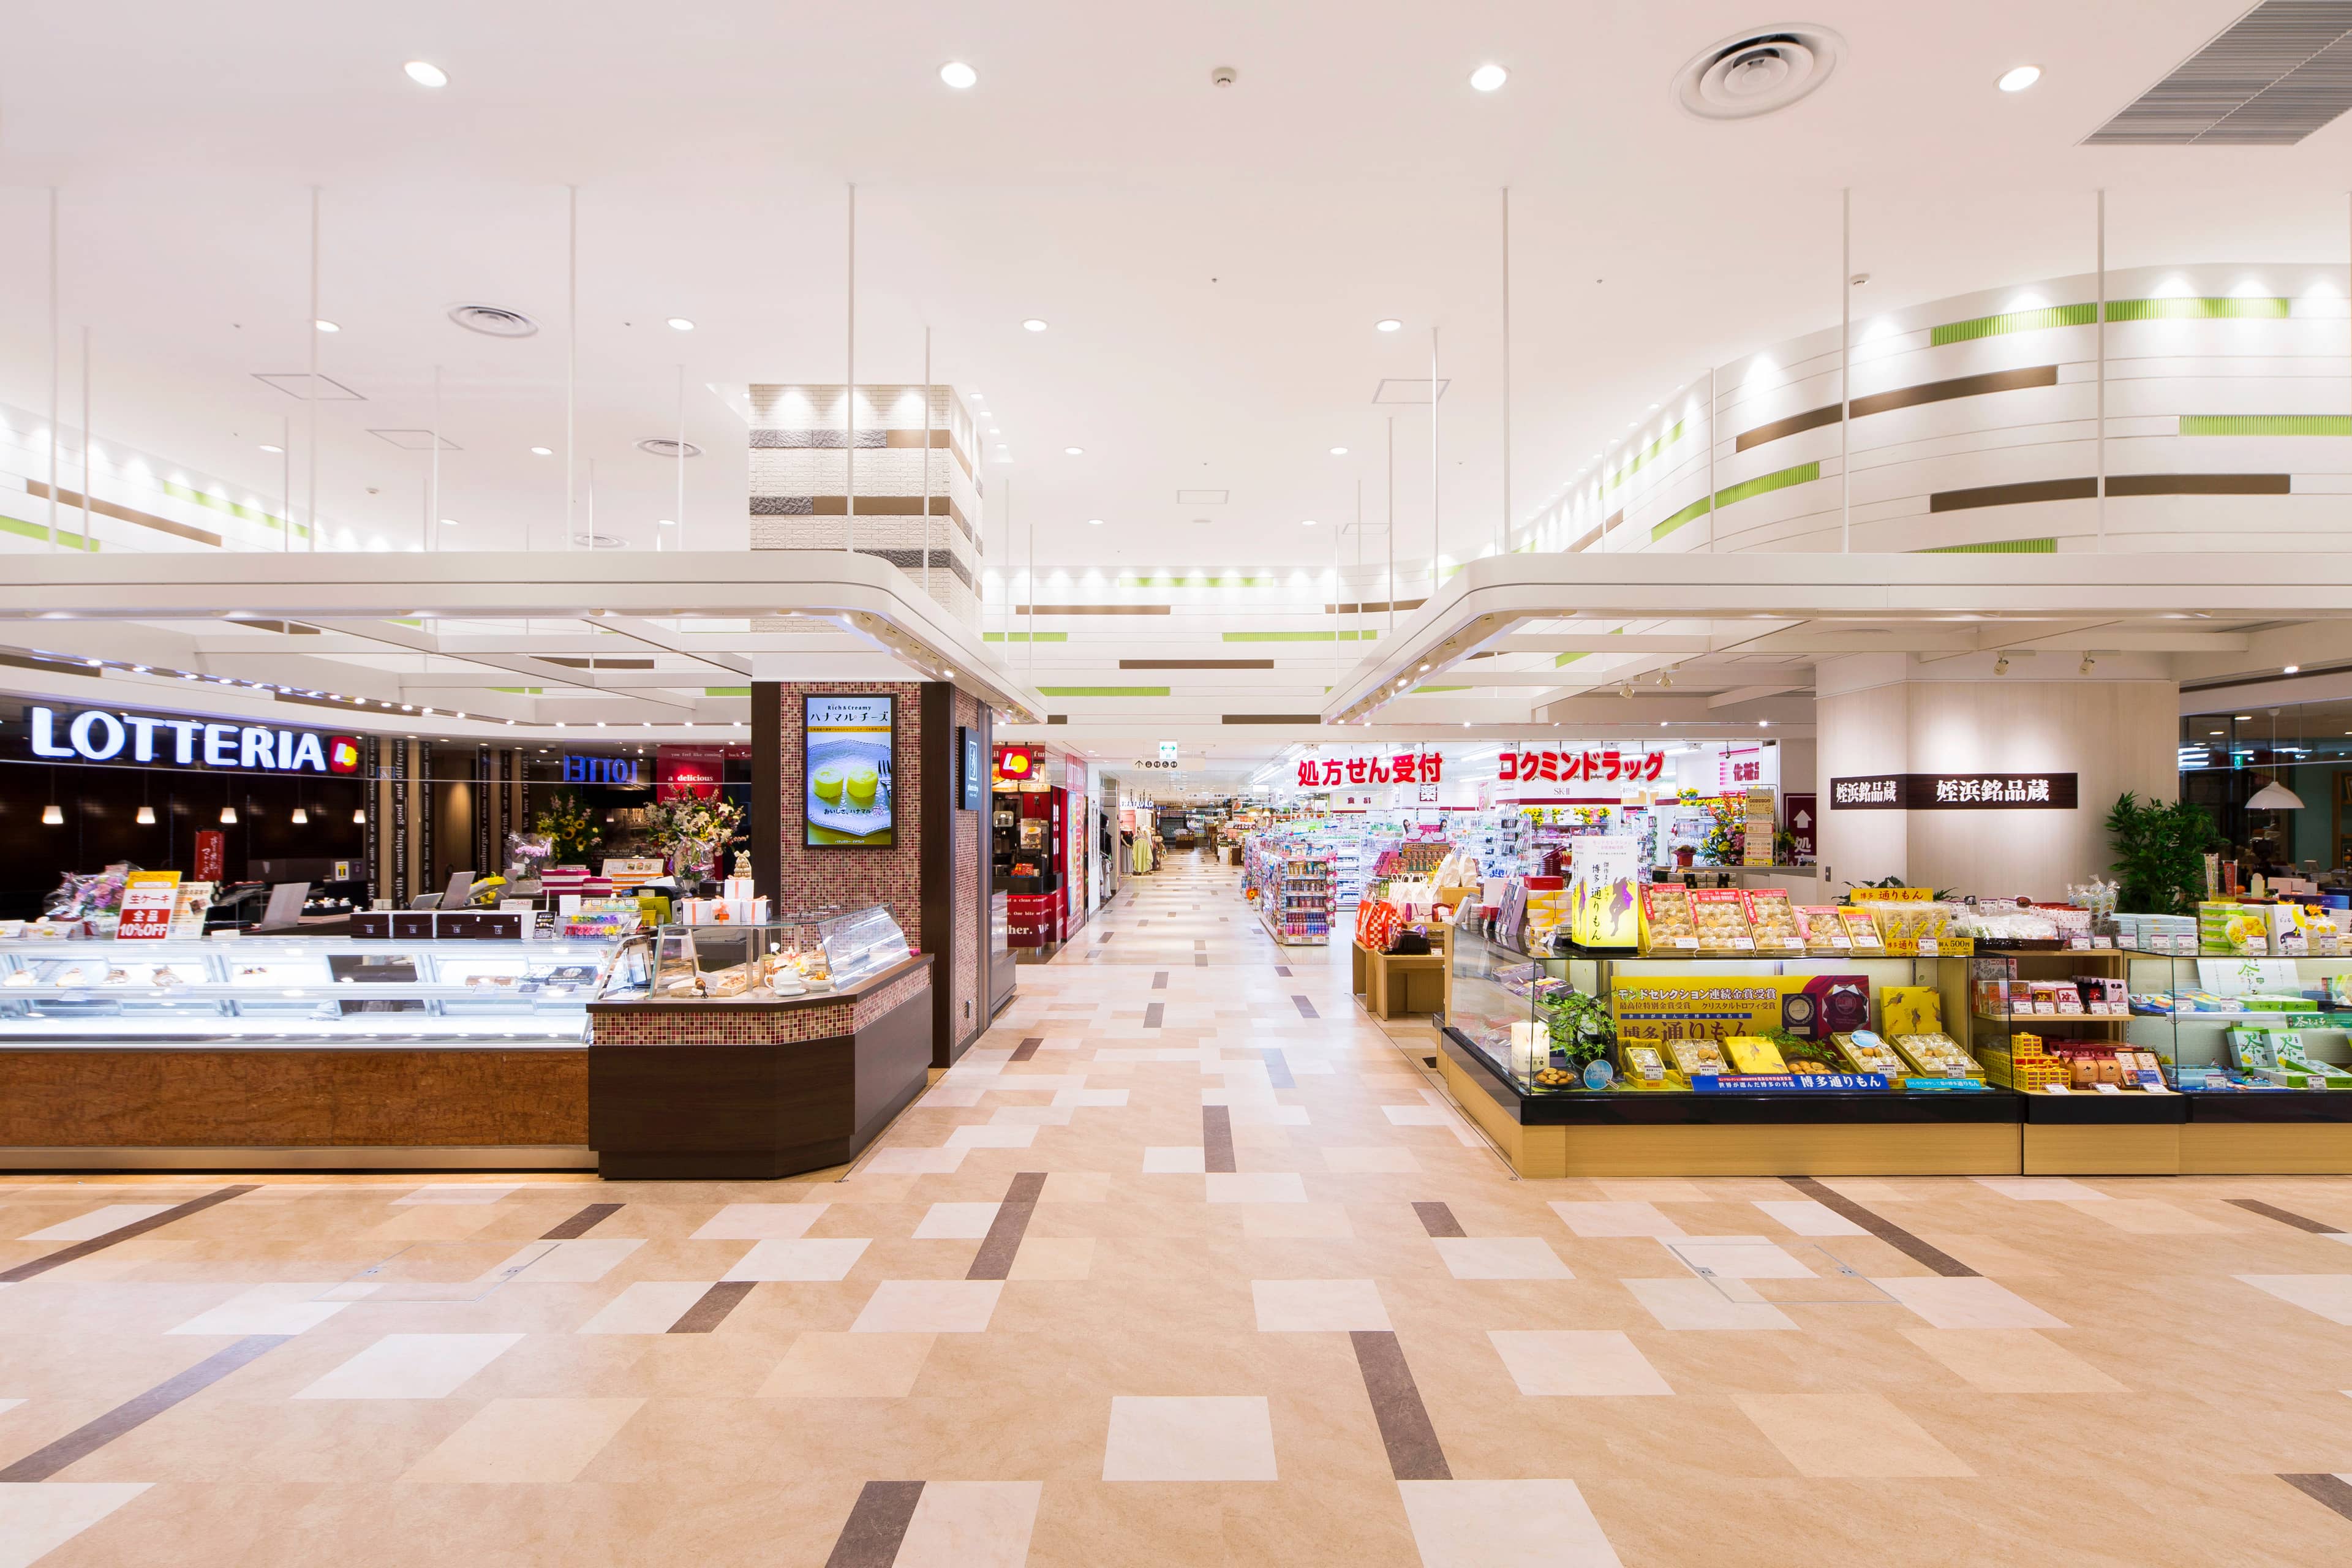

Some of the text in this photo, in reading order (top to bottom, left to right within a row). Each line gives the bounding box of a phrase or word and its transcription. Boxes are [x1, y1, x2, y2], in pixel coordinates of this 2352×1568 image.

[32, 706, 326, 772] LOTTERIA
[1297, 752, 1443, 787] 処方せん受付
[1498, 750, 1665, 782] コクミンドラッグ
[1836, 780, 1897, 804] 姪浜銘品蔵
[1936, 778, 2049, 803] 姪浜銘品蔵
[395, 804, 405, 824] good
[395, 829, 405, 873] something
[480, 826, 488, 874] hamburgers,
[129, 894, 170, 904] 生ケーキ
[1860, 891, 1923, 900] 博多通りもん
[132, 910, 159, 922] 全品
[119, 923, 167, 937] 10%OFF
[1008, 924, 1033, 935] her.
[1887, 940, 1920, 949] 博多通りも
[1618, 988, 1777, 1000] モンドセレクション連続金賞受賞
[1801, 1076, 1881, 1088] 博多通りもん
